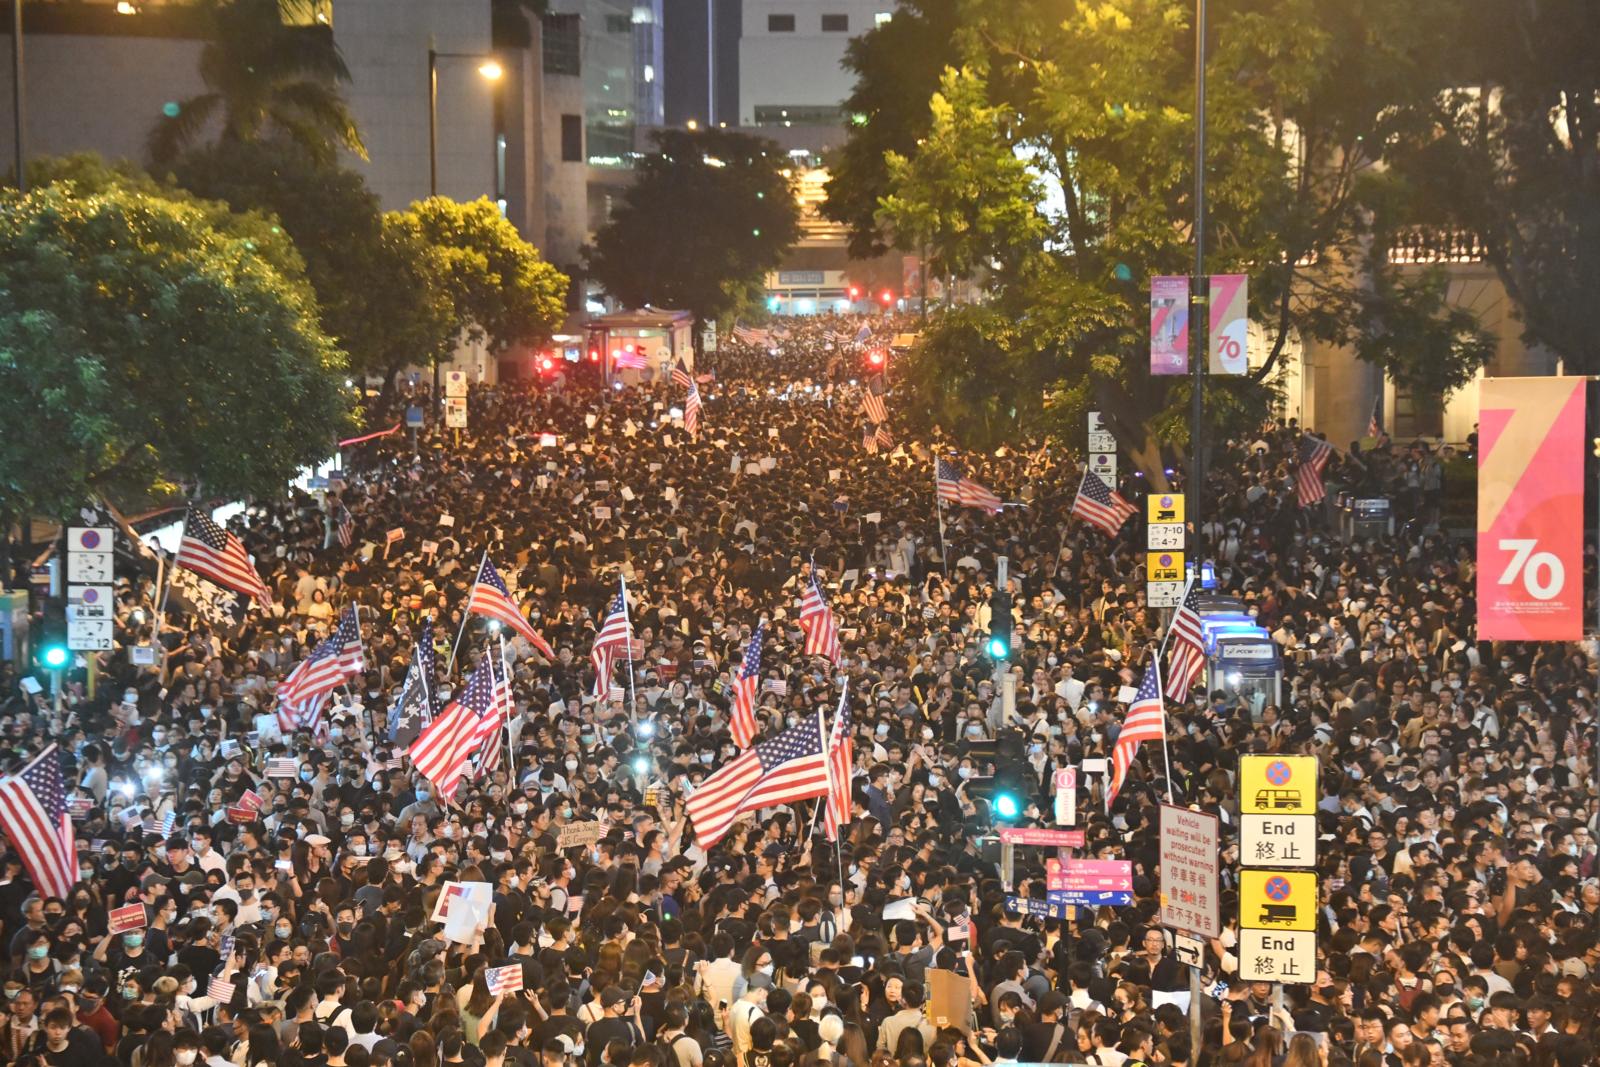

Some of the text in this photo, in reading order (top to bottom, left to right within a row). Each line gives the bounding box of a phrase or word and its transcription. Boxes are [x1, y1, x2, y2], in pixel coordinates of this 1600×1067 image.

[1217, 335, 1240, 359] 70
[1163, 526, 1183, 535] 7-10
[97, 554, 105, 565] 7
[97, 570, 105, 580] 7
[1497, 539, 1565, 600] 70
[1171, 583, 1177, 591] 7
[96, 622, 104, 632] 7
[97, 638, 110, 648] 12
[1177, 815, 1200, 829] Vehicle
[1262, 821, 1295, 836] End
[1166, 828, 1211, 845] waiting will be
[1171, 841, 1206, 857] prosecuted
[1255, 841, 1301, 860] 終止
[1164, 852, 1214, 874] without warning
[1261, 936, 1295, 951] End
[1254, 956, 1300, 976] 終止
